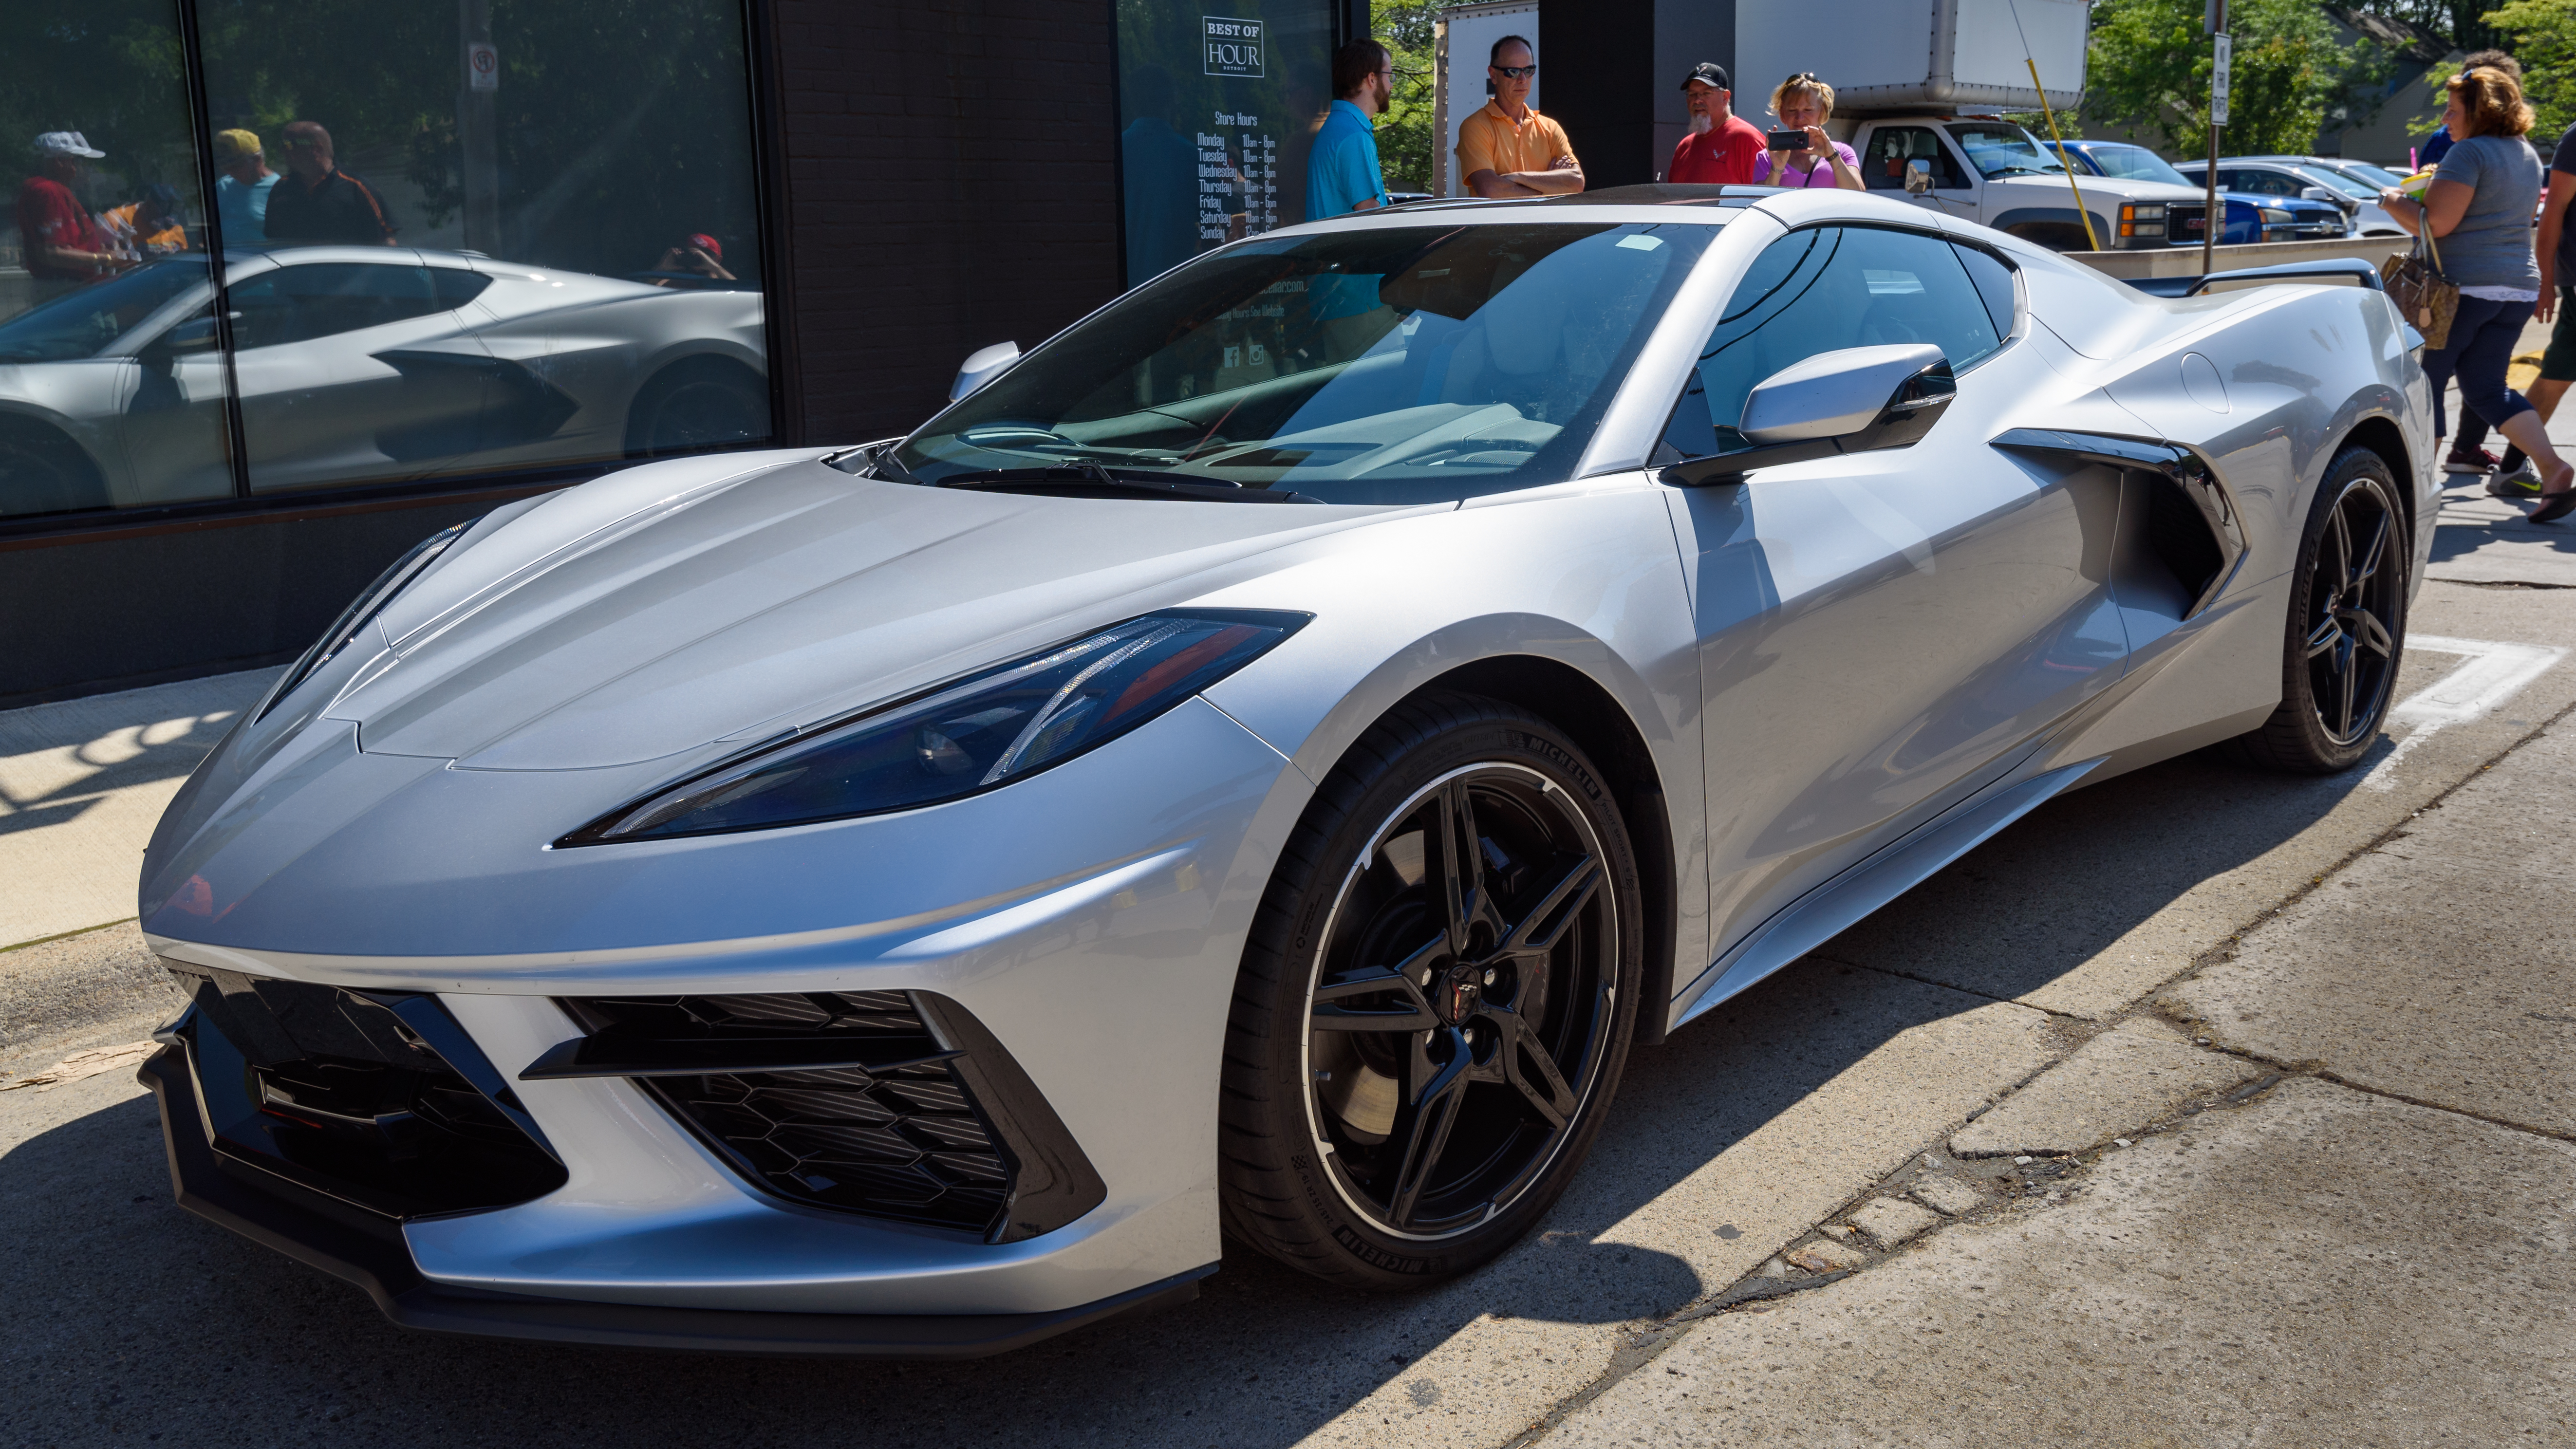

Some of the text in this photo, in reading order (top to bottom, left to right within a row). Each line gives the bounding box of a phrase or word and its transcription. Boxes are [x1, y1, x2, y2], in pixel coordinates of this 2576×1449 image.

[1207, 23, 1259, 37] BEST OF
[1208, 43, 1260, 66] HOUR
[1215, 111, 1257, 126] Store Hours
[1197, 132, 1224, 150] Monday
[1242, 134, 1257, 147] 10am
[1264, 135, 1275, 150] 8pm
[1197, 148, 1227, 166] Tuesday
[1243, 149, 1257, 163] 10am
[1264, 150, 1275, 165] 8pm
[1198, 164, 1237, 182] Wednesday
[1243, 165, 1258, 177] 10am
[1265, 165, 1276, 180] 8pm
[1199, 179, 1232, 196] Thursday
[1244, 180, 1258, 193] 10am
[1265, 180, 1276, 195] 8pm
[1200, 195, 1221, 212] Friday
[1244, 195, 1259, 208] 10am
[1265, 195, 1276, 210] 6pm
[1200, 210, 1231, 227] Saturday
[1245, 210, 1259, 223] 10am
[1266, 210, 1277, 225] 6pm
[1201, 225, 1225, 242] Sunday
[1262, 304, 1285, 317] Website
[1528, 737, 1598, 797] MICHELIN
[1601, 801, 1616, 827] PILOT
[1613, 827, 1627, 859] SPORT
[1308, 892, 1324, 924] Performance
[1300, 901, 1314, 934] MICHELIN
[1301, 1173, 1334, 1225] 245/35 ZR 19
[1336, 1228, 1424, 1272] MICHELIN
